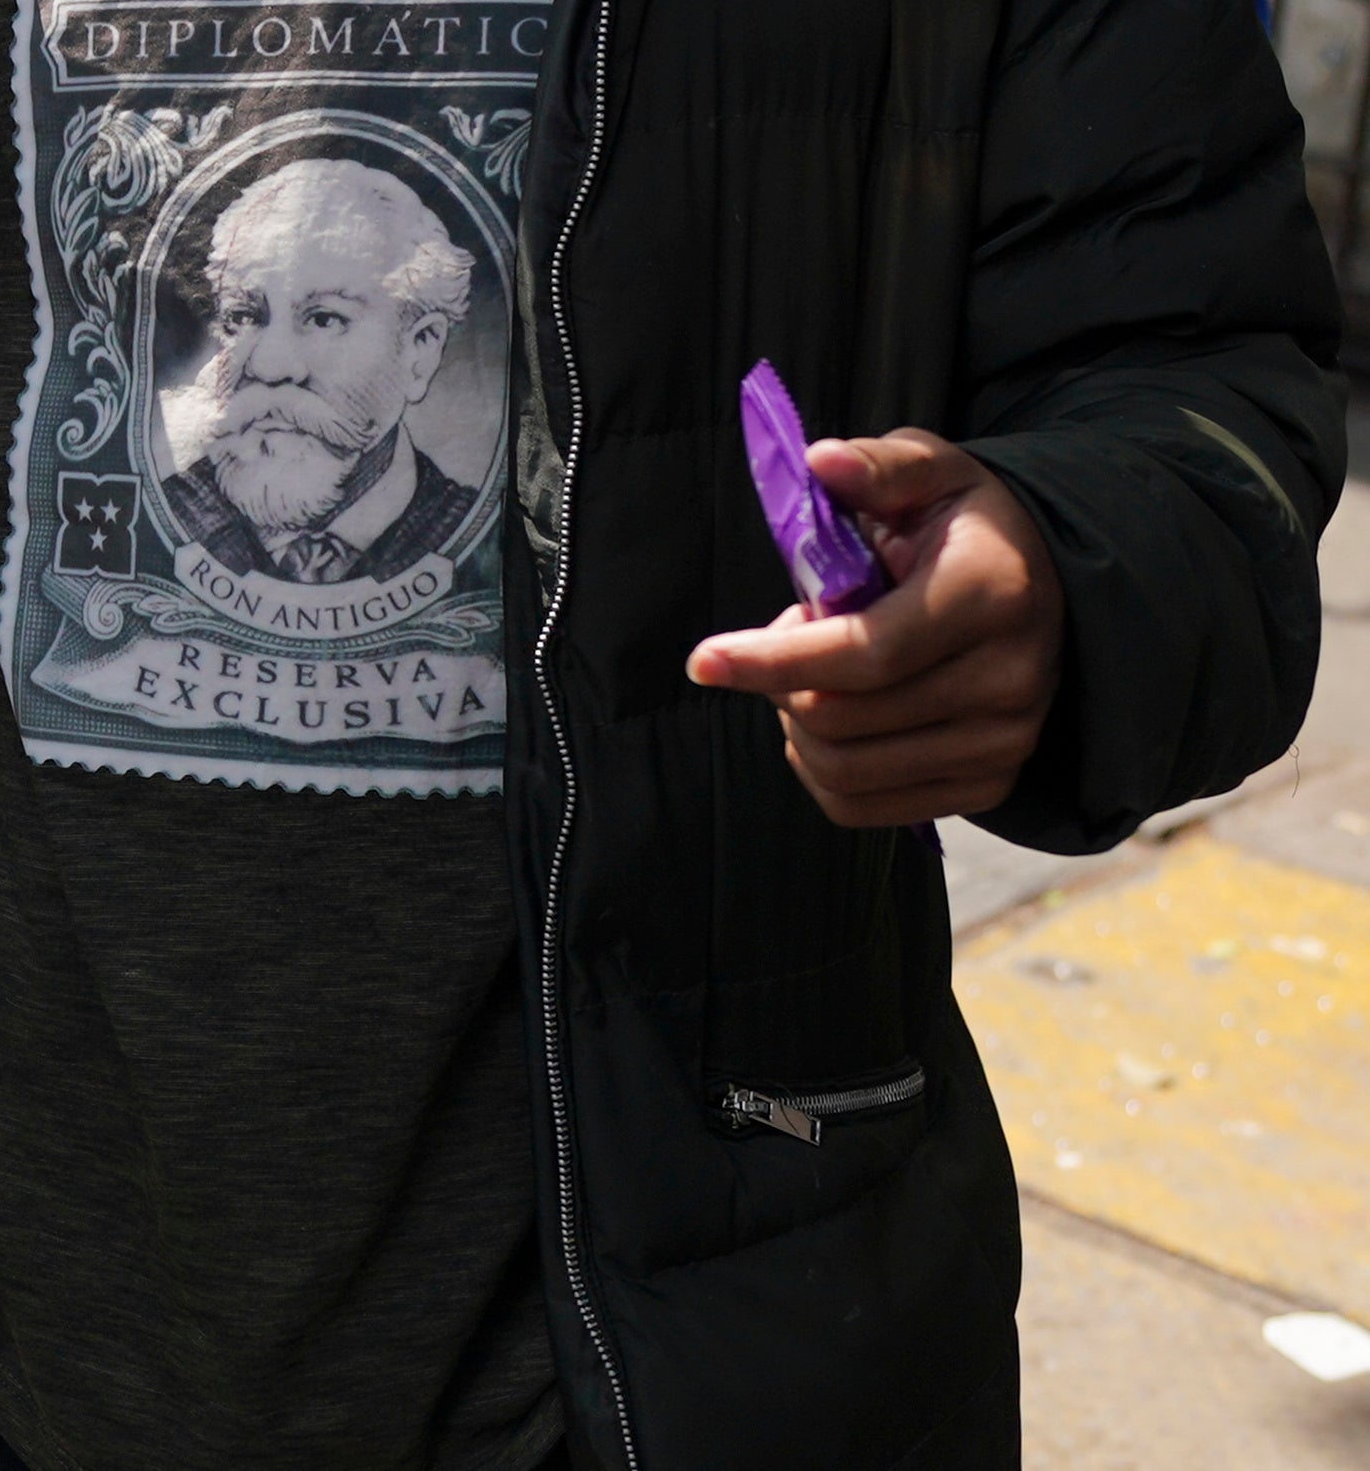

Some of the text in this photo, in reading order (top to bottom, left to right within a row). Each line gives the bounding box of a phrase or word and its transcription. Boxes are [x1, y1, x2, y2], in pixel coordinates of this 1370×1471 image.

[84, 10, 549, 61] DIPLOMÁTIC
[189, 558, 439, 630] RON ANTIGUO
[177, 643, 438, 689] RESERVA
[134, 665, 486, 730] EXCLUSIVA
